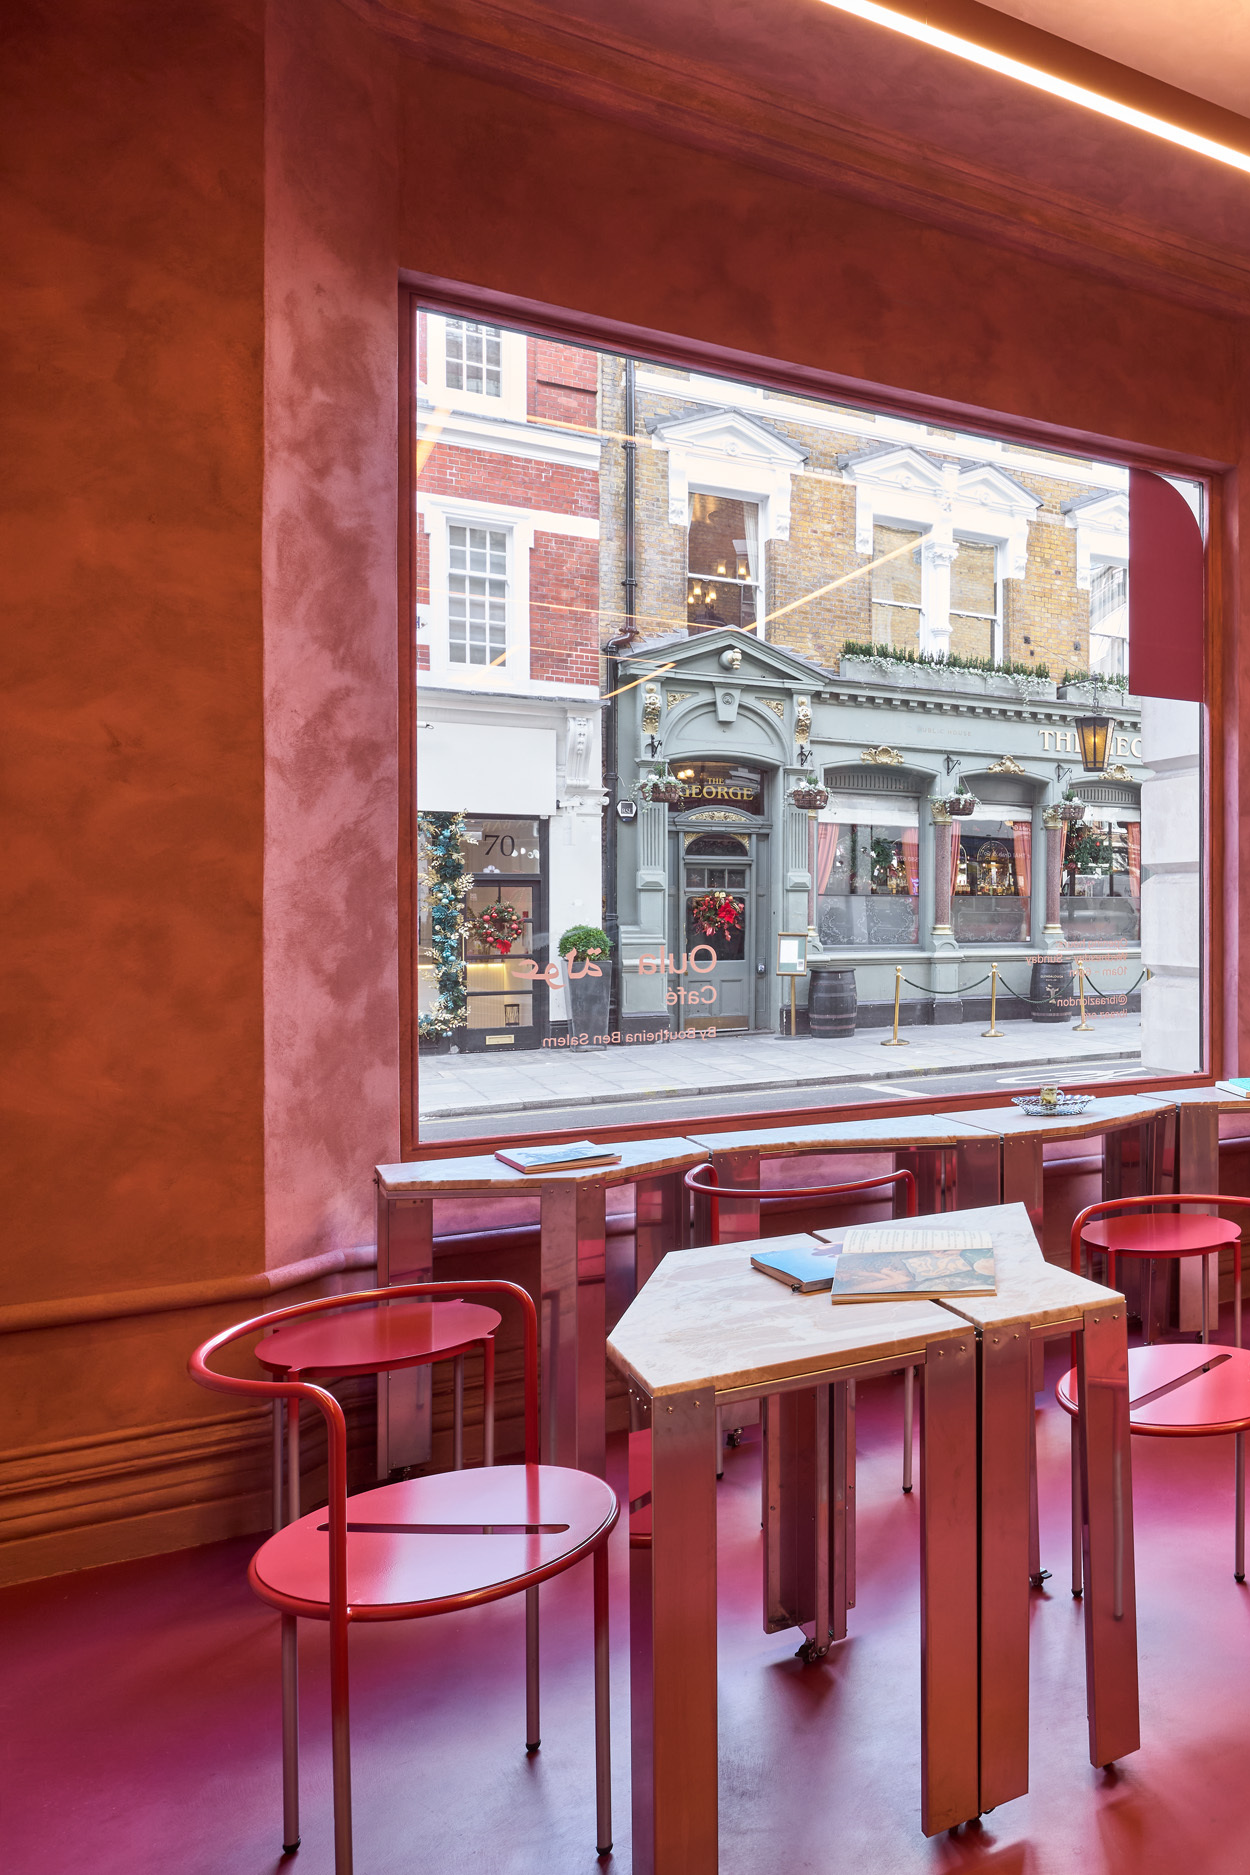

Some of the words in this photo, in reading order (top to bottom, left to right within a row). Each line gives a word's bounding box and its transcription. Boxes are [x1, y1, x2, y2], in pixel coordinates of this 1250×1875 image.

[707, 777, 724, 785] THE
[679, 785, 753, 800] GEORGE
[484, 834, 515, 857] 70
